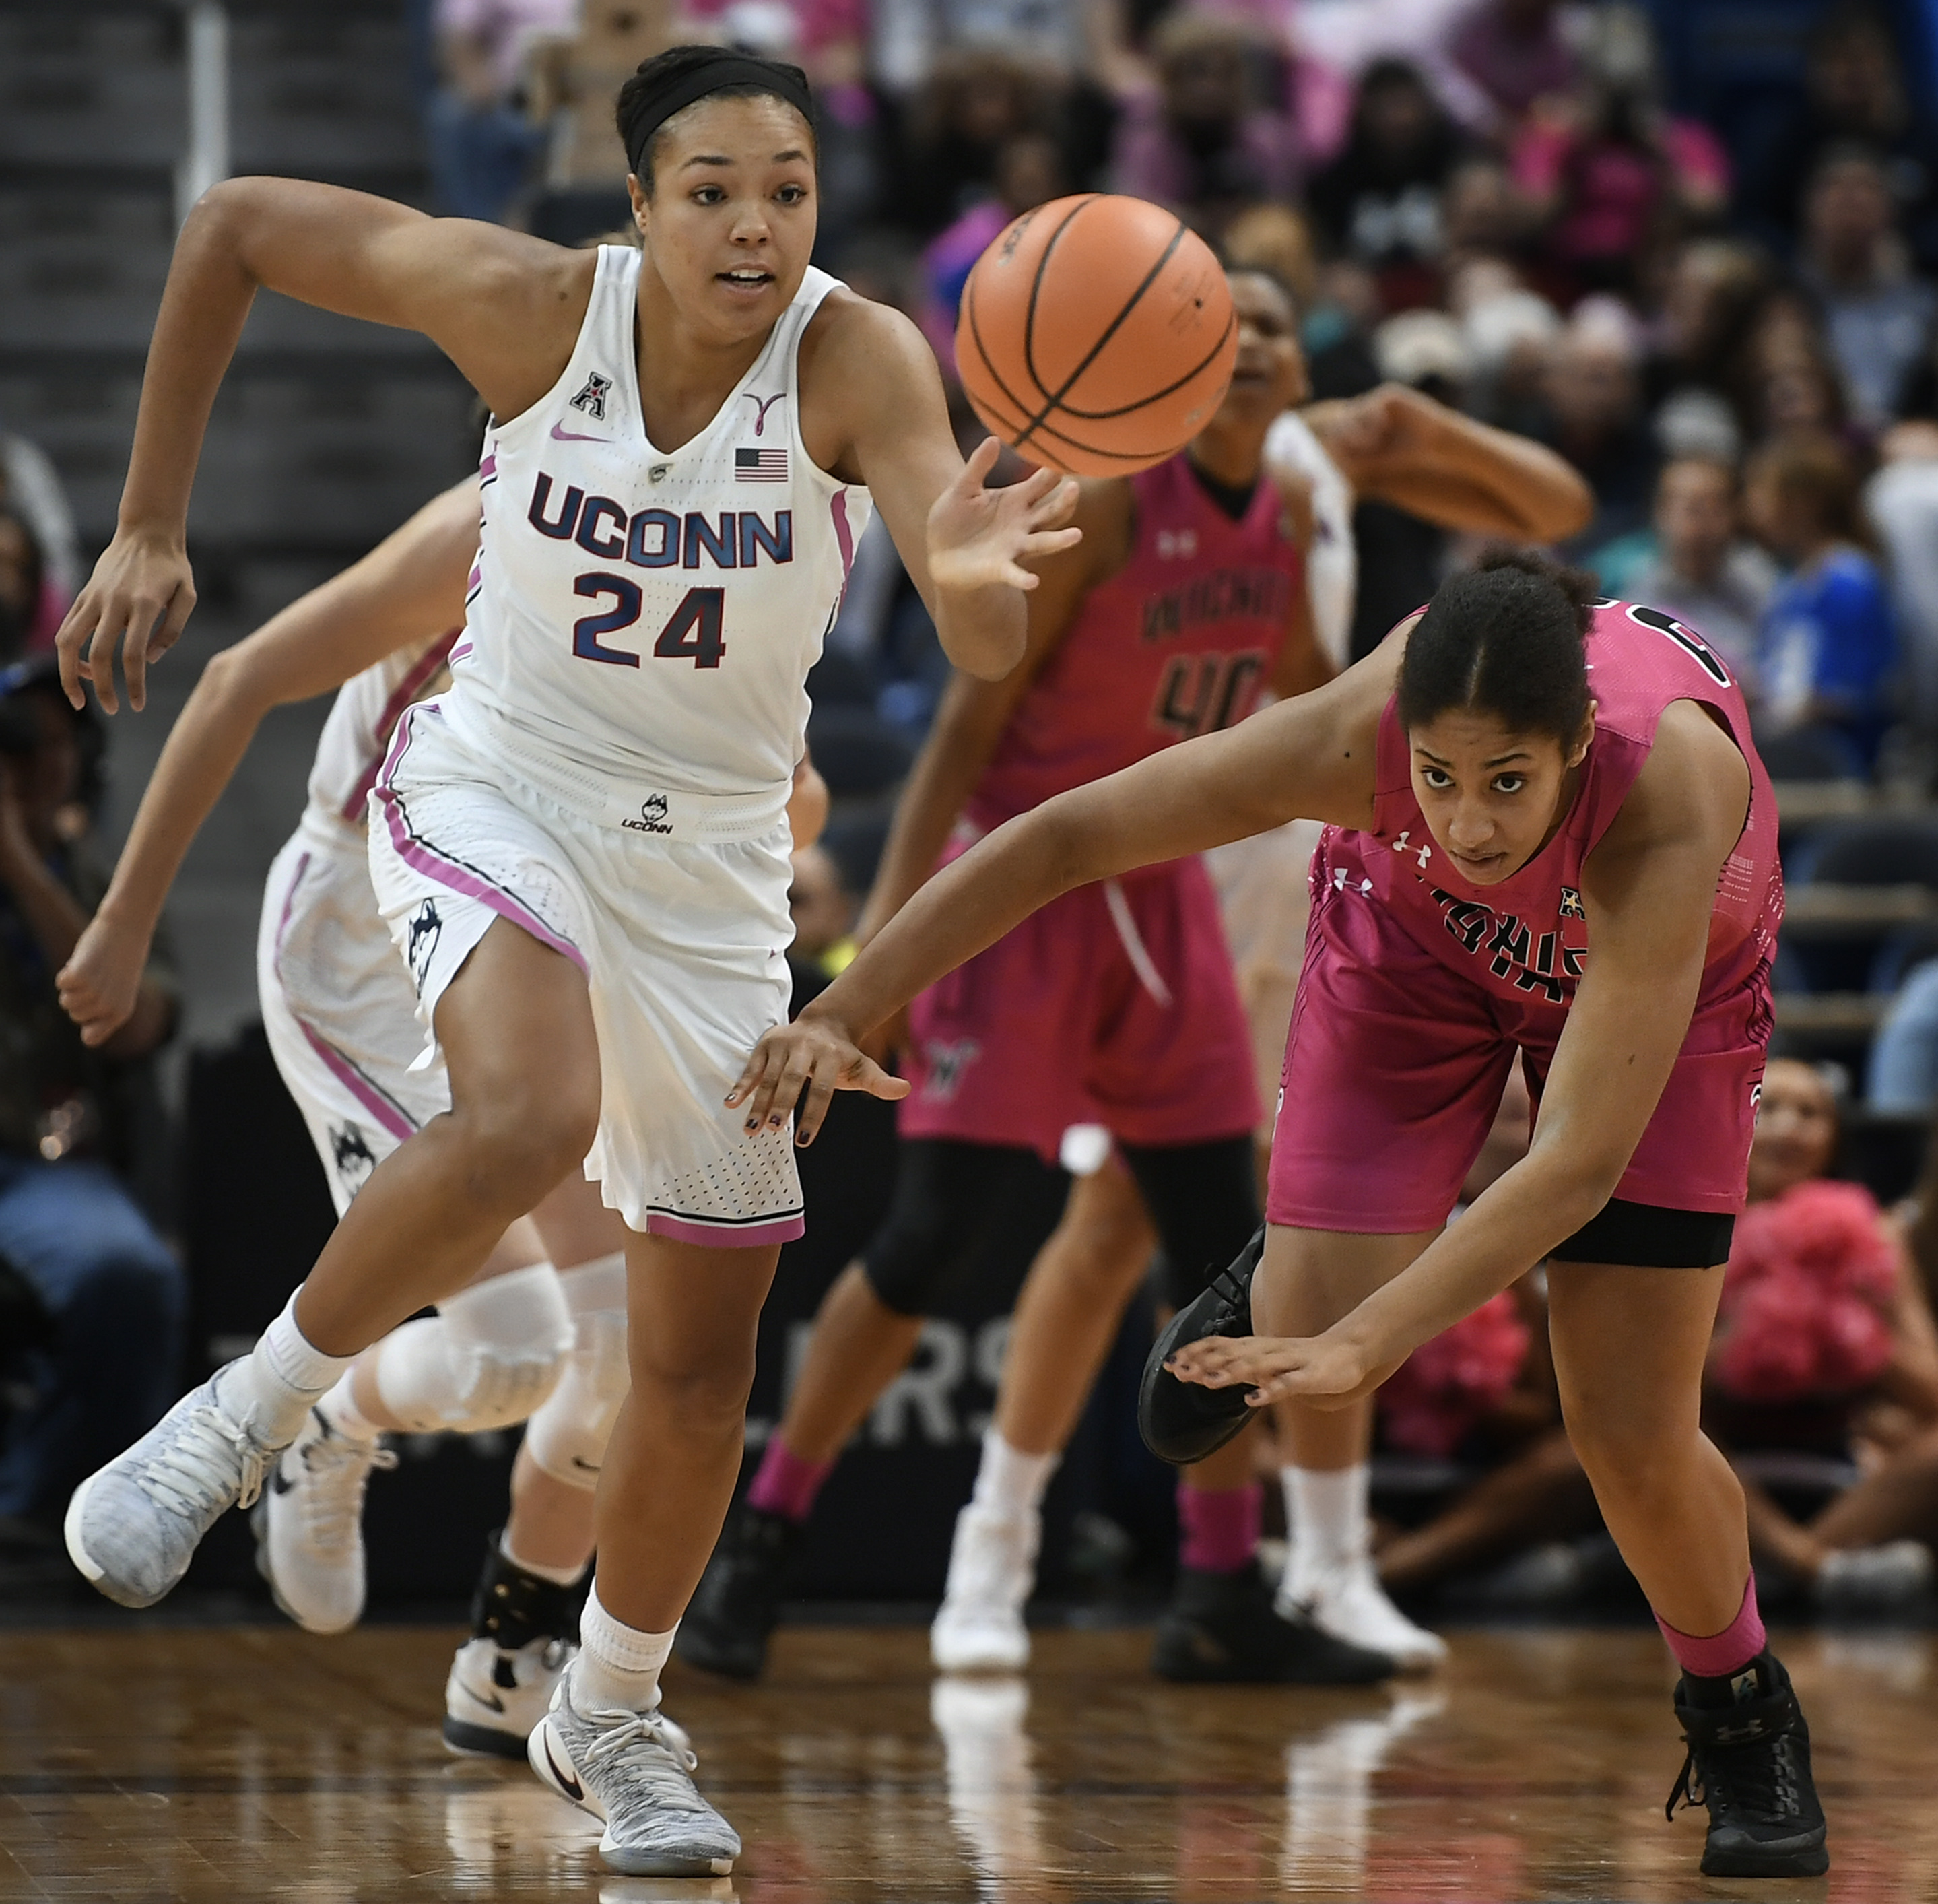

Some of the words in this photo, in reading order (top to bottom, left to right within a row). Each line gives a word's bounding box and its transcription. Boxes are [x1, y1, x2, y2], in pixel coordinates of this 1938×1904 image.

[527, 471, 793, 570] UCONN
[572, 571, 727, 670] 24
[620, 818, 674, 835] UCONN
